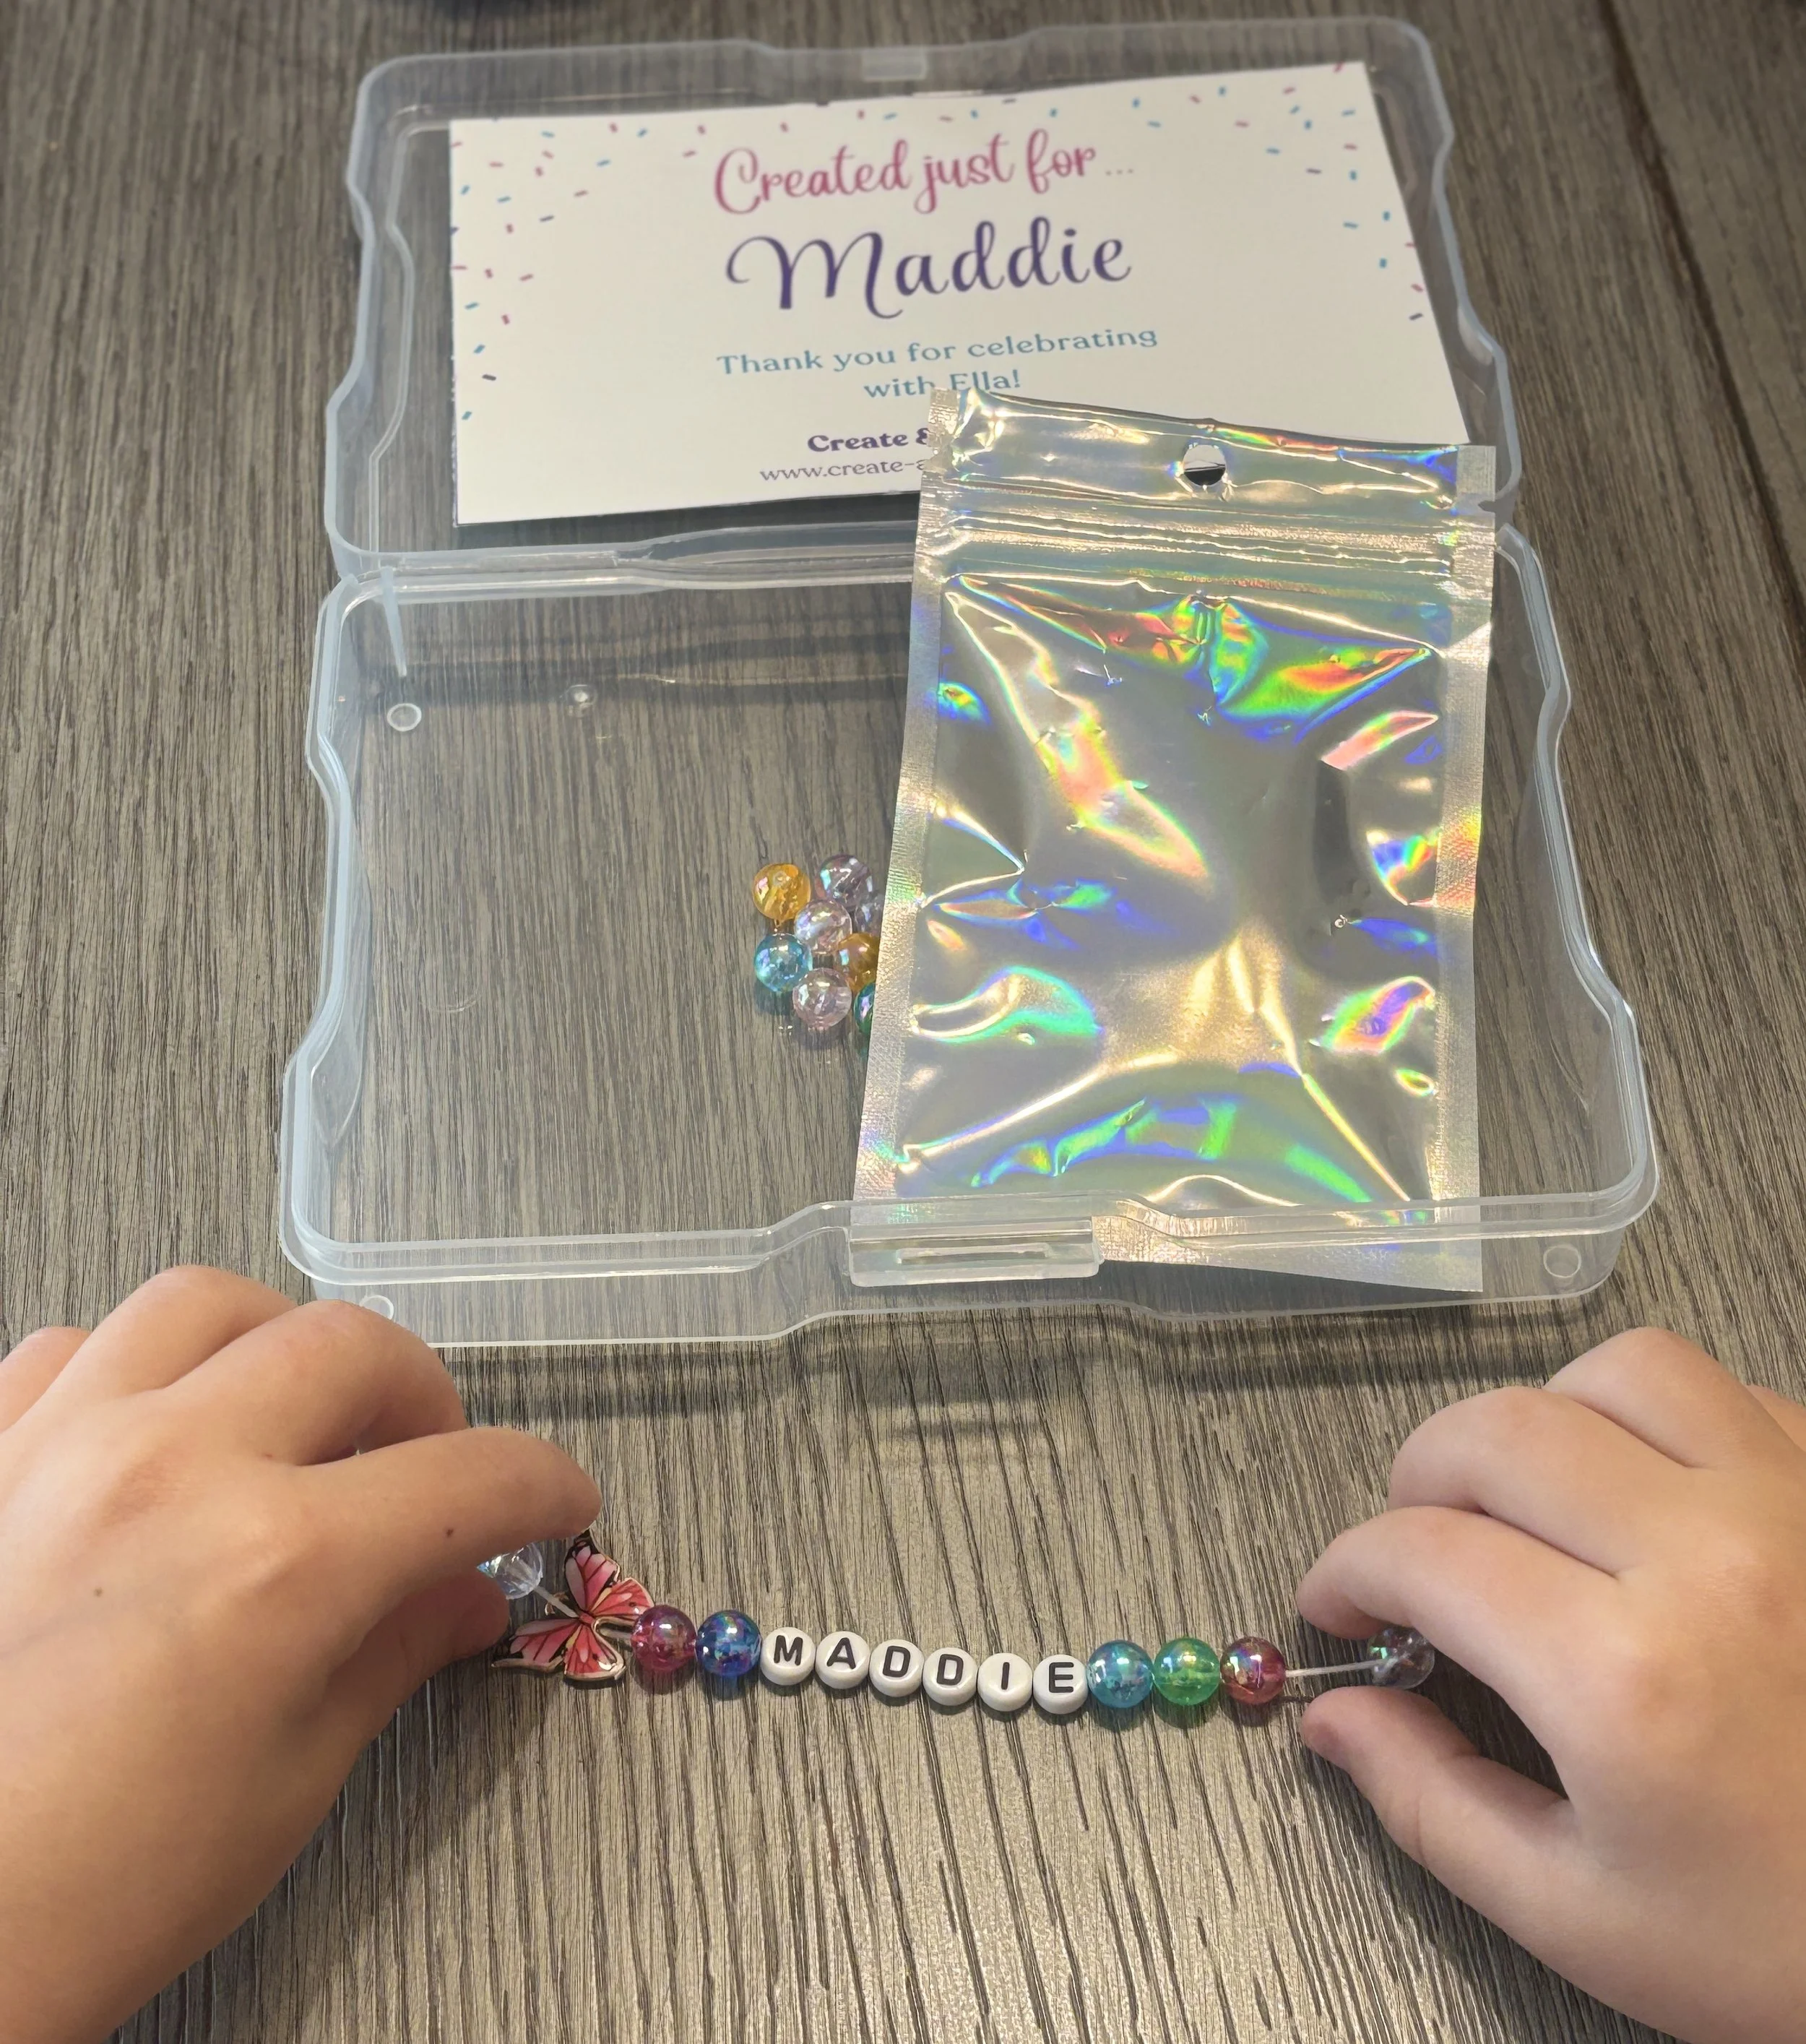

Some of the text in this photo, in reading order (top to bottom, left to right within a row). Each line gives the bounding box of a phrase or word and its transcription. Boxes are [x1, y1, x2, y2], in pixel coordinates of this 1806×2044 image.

[714, 139, 912, 215] Created
[914, 133, 1014, 215] just
[725, 217, 1131, 319] Maddie
[716, 328, 1158, 376] Thank you for celebrating
[863, 369, 1021, 398] with Ella!
[807, 433, 908, 453] Create
[774, 1634, 1075, 1694] MADDIE
